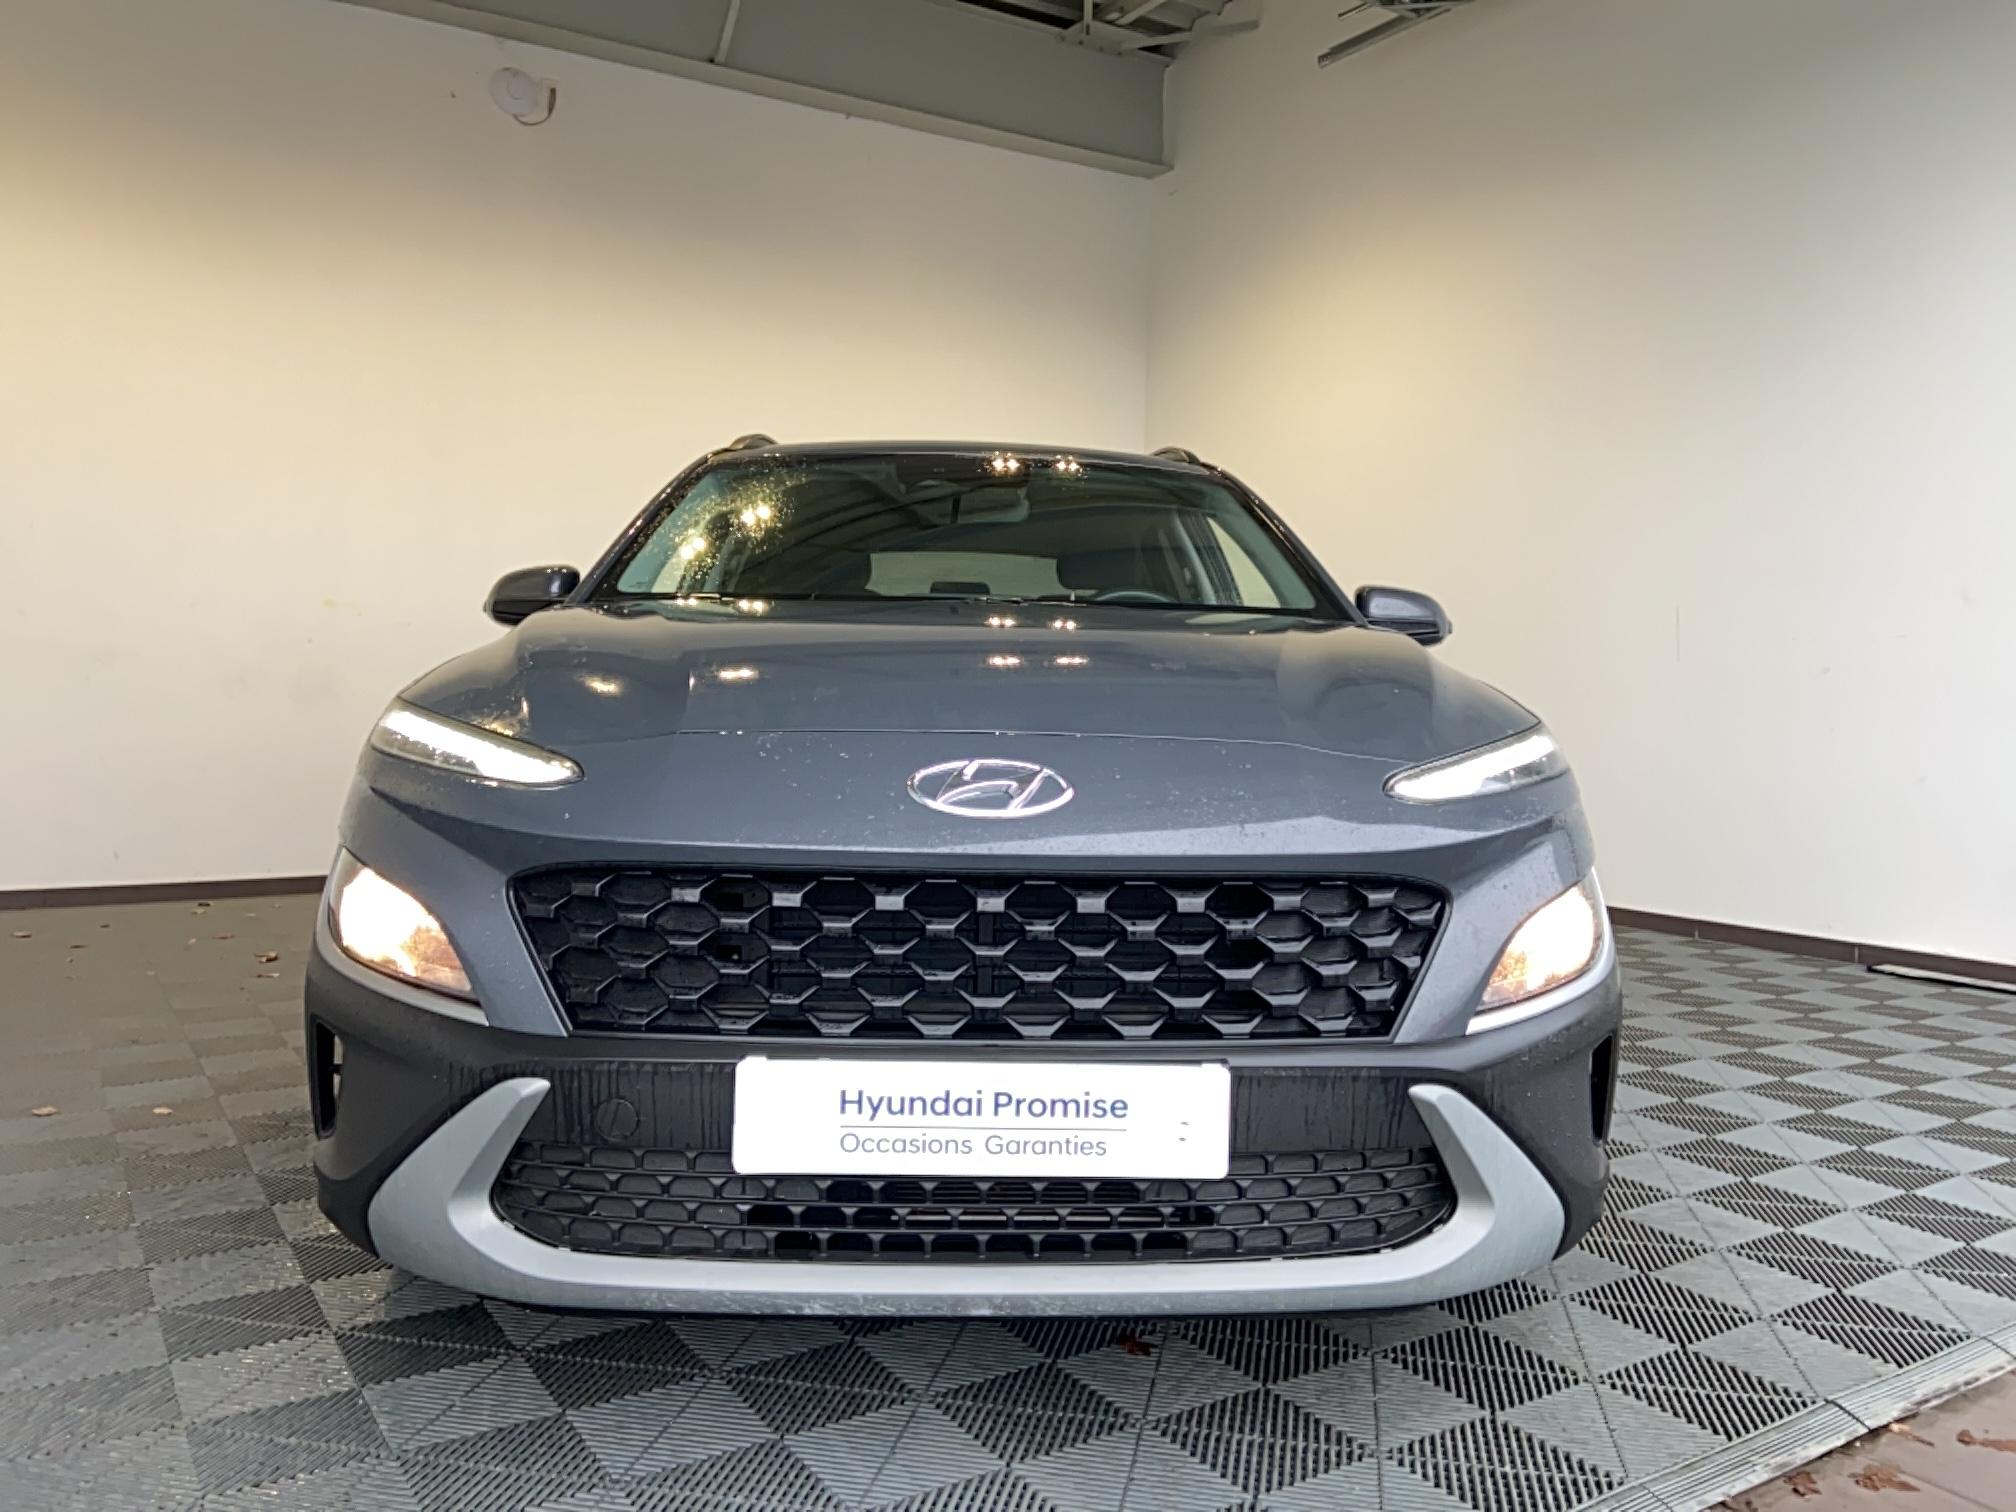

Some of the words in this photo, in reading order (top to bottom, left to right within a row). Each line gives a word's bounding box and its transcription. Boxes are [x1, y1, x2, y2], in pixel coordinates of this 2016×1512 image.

[839, 1089, 983, 1122] Hyundai
[993, 1090, 1129, 1119] Promise
[839, 1132, 973, 1155] Occasions
[984, 1134, 1107, 1157] Garanties
